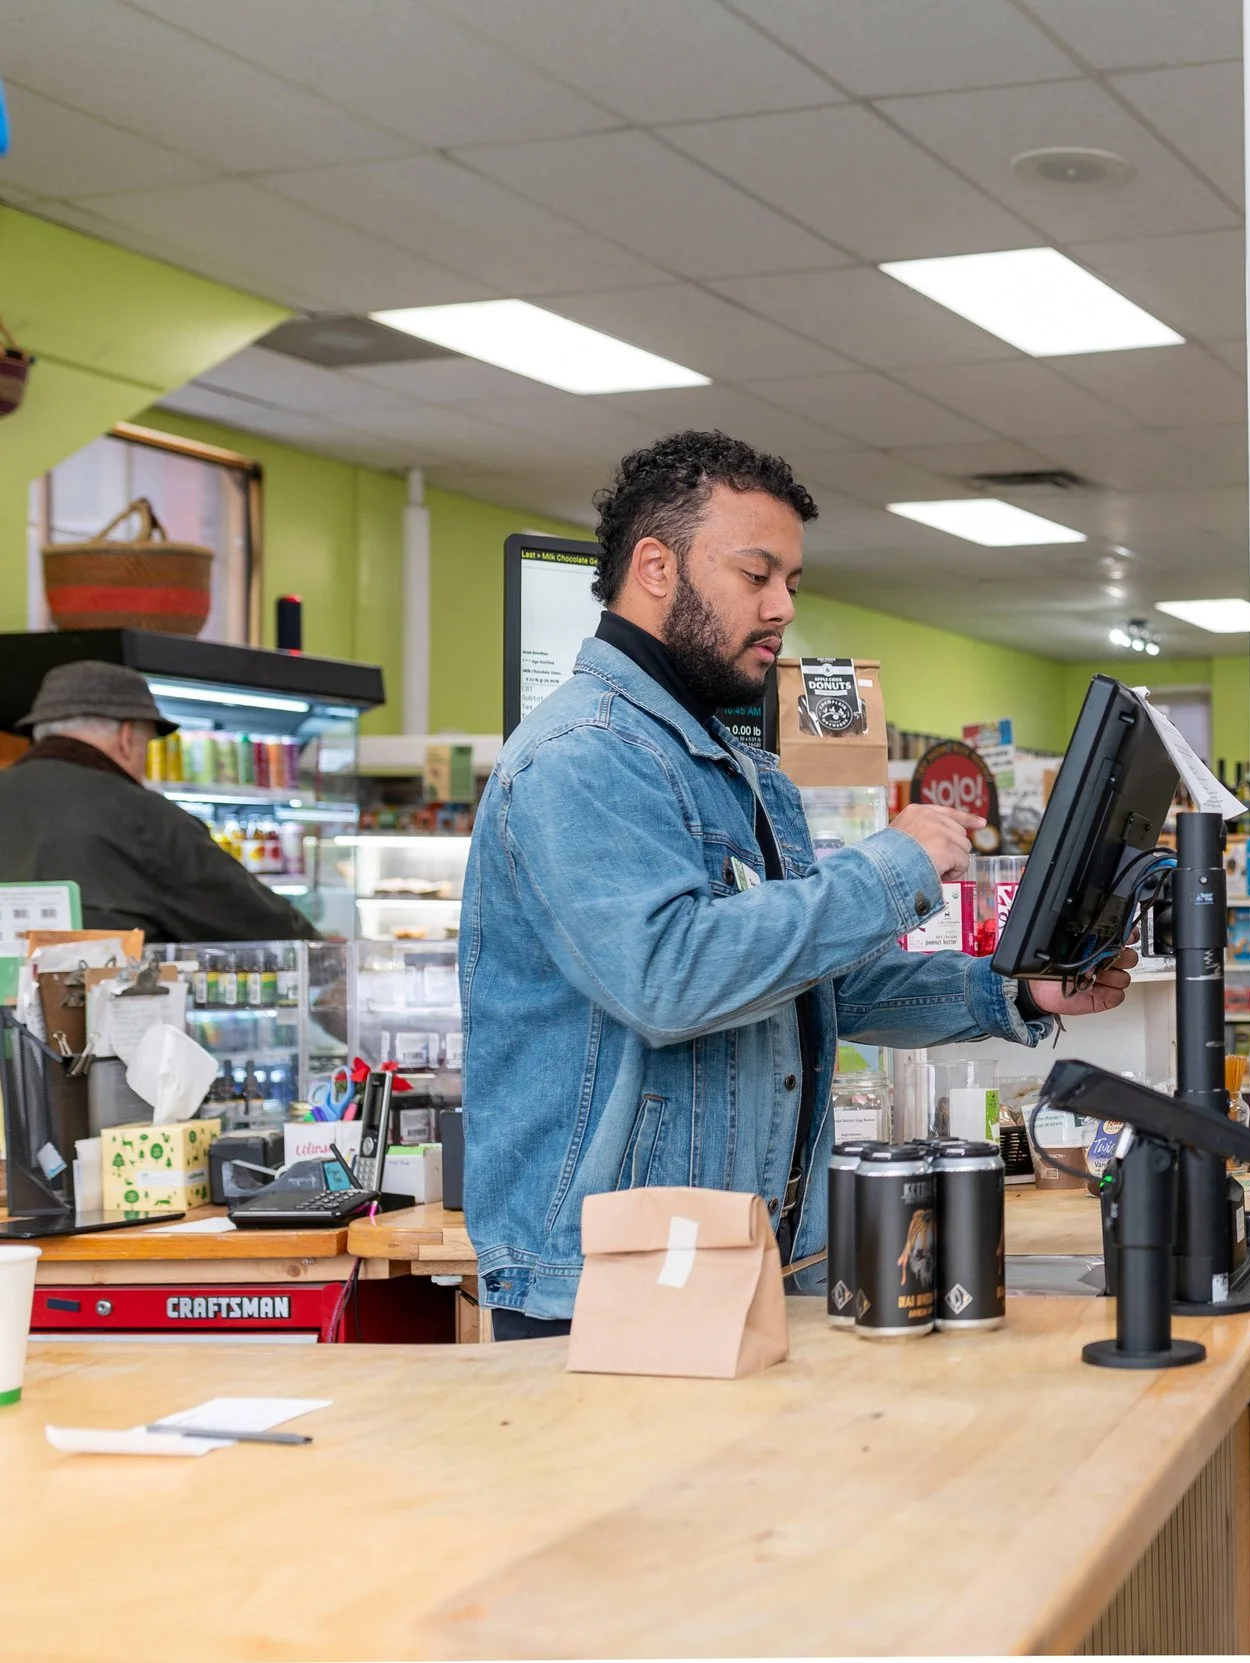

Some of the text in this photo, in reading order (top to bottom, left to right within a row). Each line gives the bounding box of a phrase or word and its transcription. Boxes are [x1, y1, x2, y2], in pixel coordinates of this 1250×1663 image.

[521, 550, 535, 559] Last
[542, 552, 556, 561] Milk
[557, 554, 589, 564] Chocolate
[808, 681, 852, 690] DONUTS
[747, 707, 761, 716] AM
[732, 725, 761, 736] 0.00 lb
[166, 1296, 291, 1319] CRAFTSMAN
